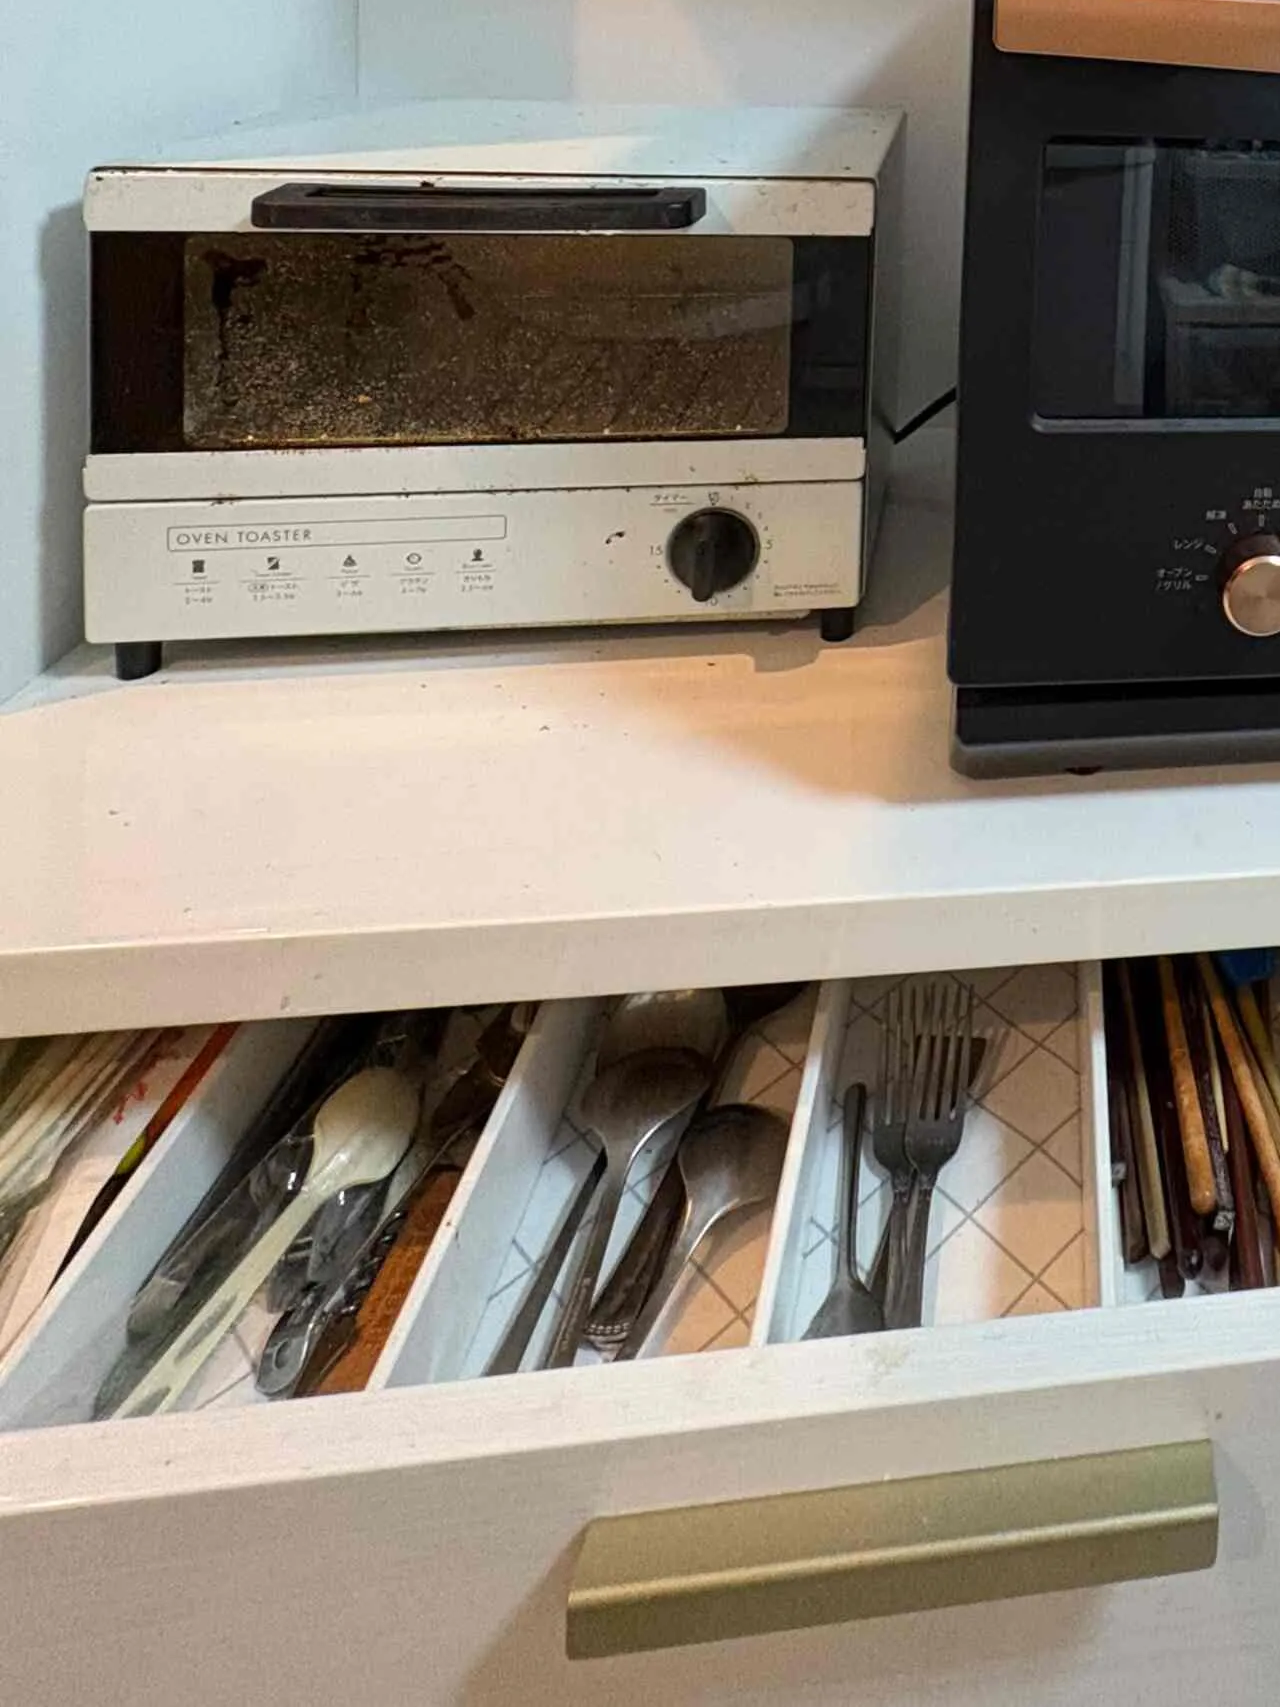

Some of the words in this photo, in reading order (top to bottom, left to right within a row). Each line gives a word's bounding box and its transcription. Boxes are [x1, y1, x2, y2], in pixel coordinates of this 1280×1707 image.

[176, 532, 229, 546] OVEN
[236, 528, 313, 543] TOASTER
[649, 545, 664, 556] 15
[764, 539, 774, 551] 5
